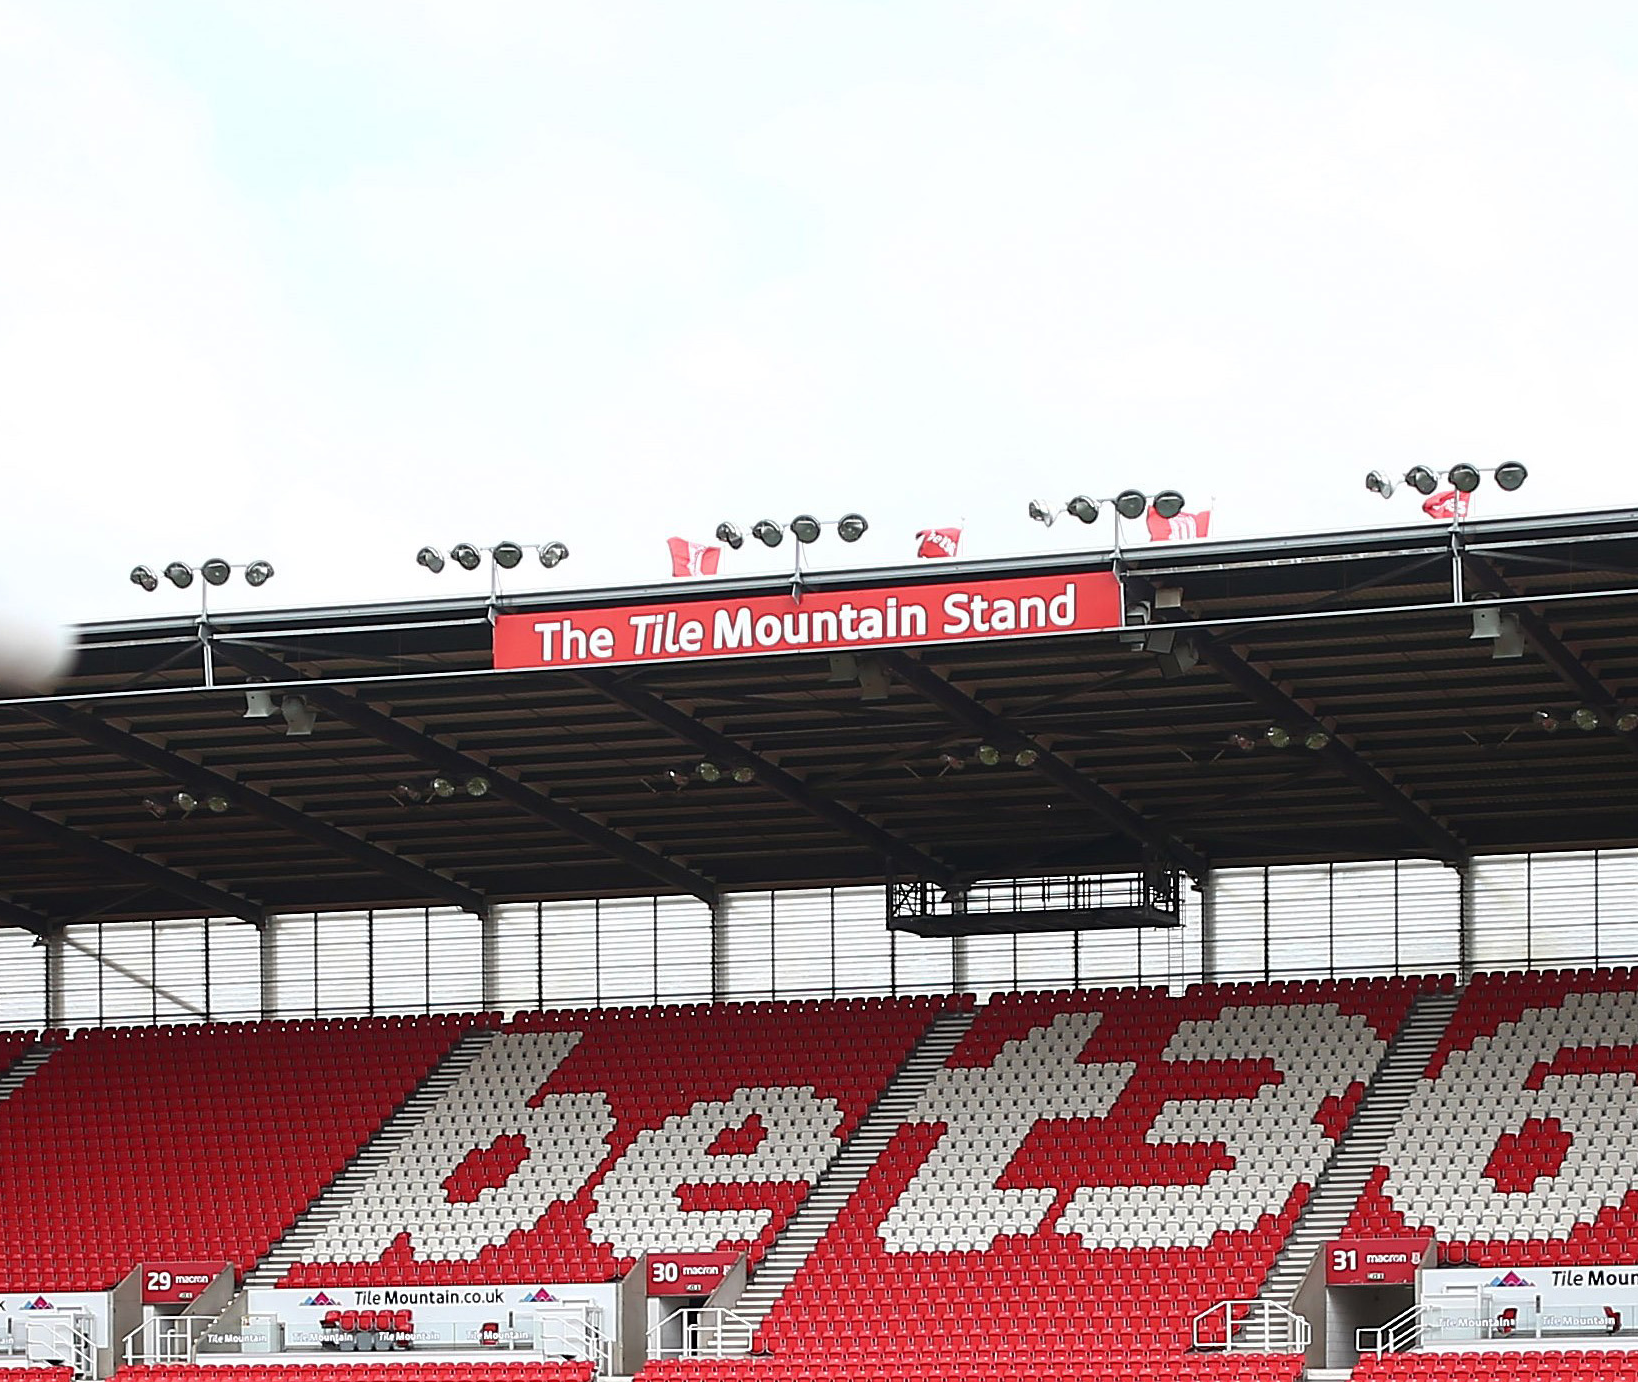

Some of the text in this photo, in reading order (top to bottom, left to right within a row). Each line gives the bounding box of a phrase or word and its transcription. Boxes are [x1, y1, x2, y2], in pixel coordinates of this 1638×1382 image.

[534, 581, 1077, 661] The Tile Mountain Stand
[1332, 1250, 1407, 1272] 31 macron
[146, 1271, 209, 1291] 29 macron
[651, 1262, 719, 1283] 30 macron
[1551, 1270, 1584, 1287] Tile
[354, 1287, 505, 1306] Tile Mountain.co.uk
